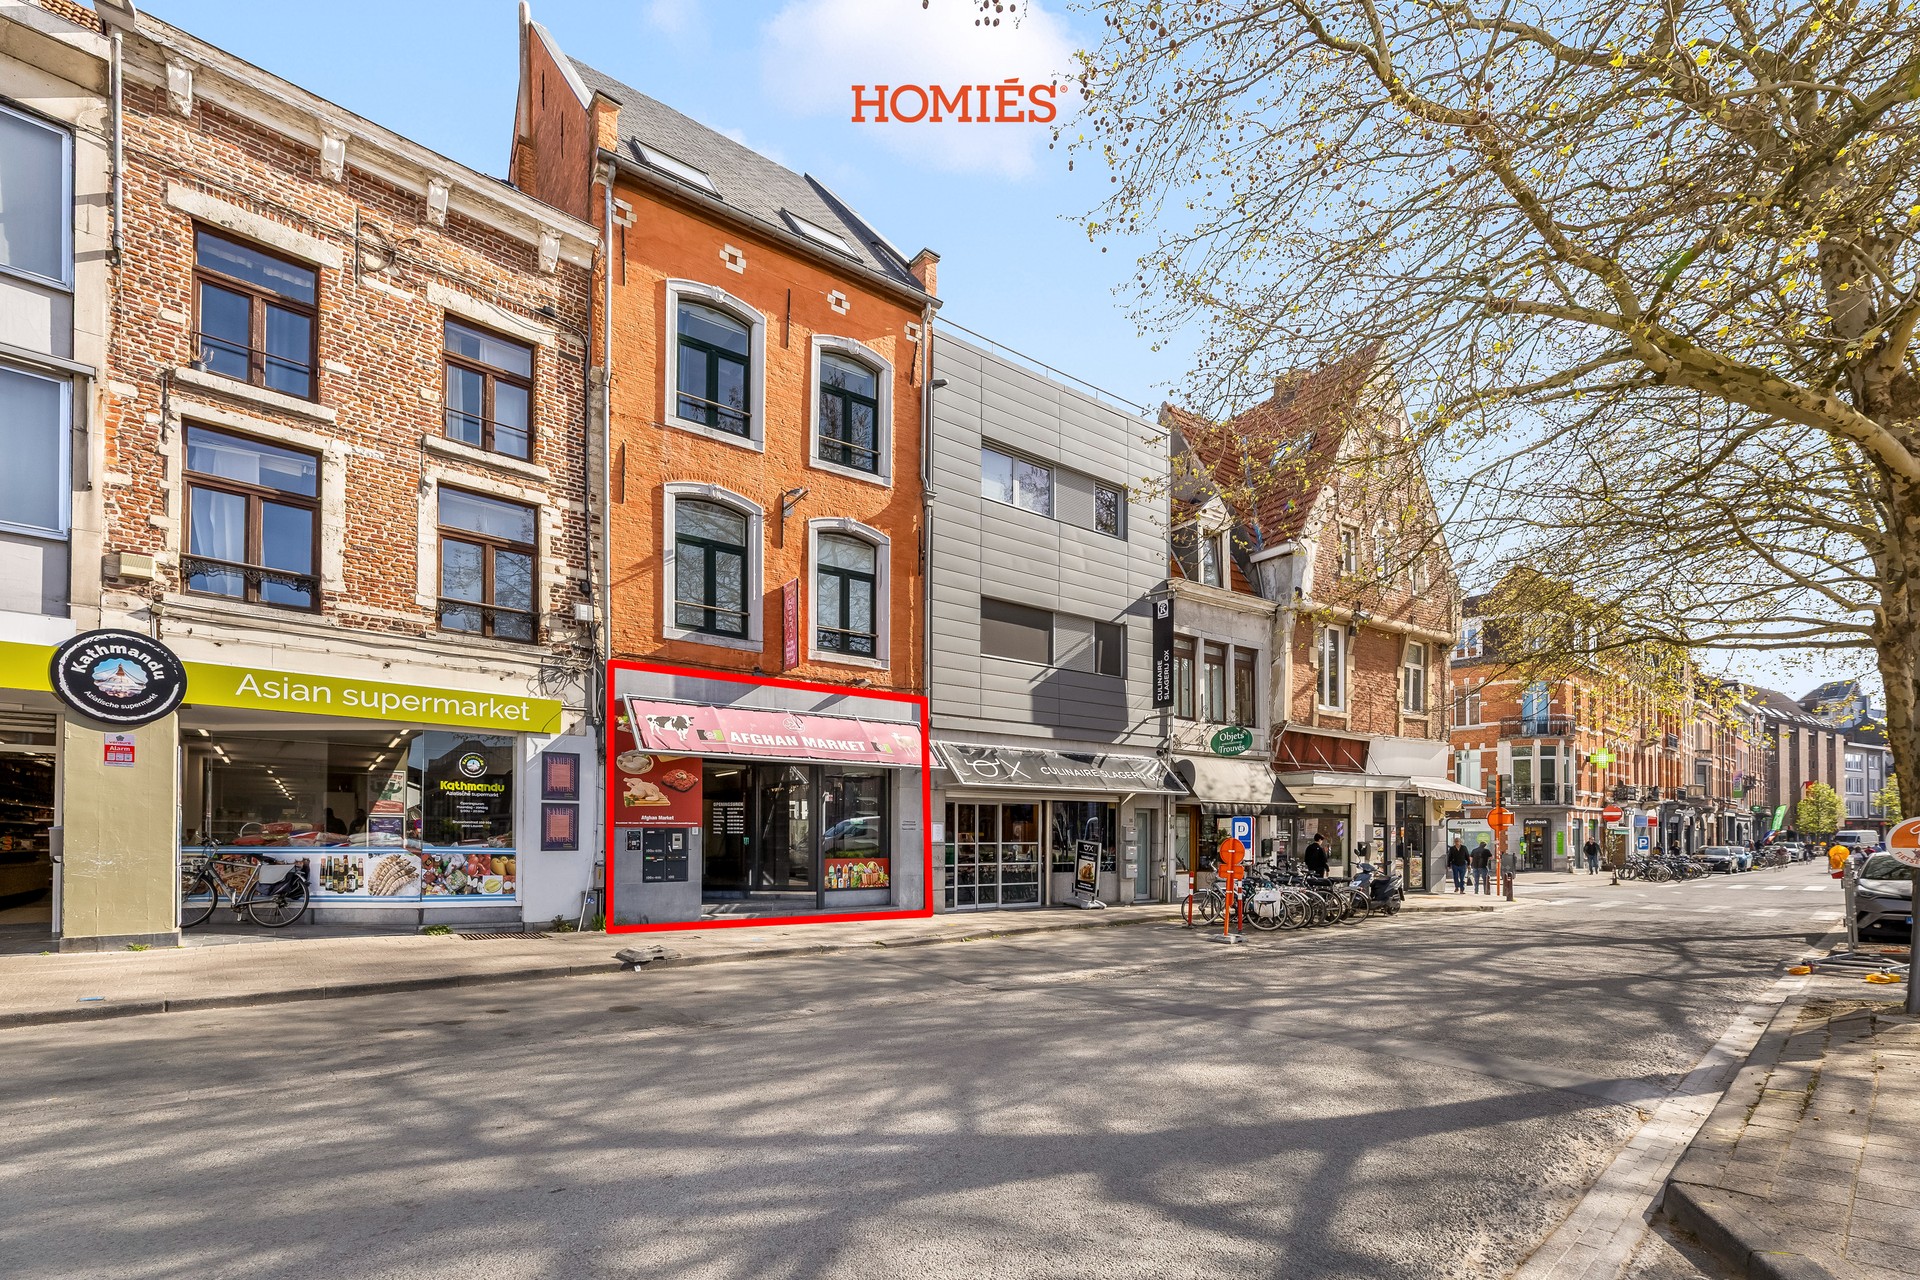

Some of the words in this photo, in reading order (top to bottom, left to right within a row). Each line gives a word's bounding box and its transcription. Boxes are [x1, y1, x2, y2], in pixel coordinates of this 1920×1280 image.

[70, 644, 165, 680] Kathmandu
[1163, 649, 1170, 662] OX
[84, 690, 120, 709] Aziatische
[120, 692, 159, 710] supermarkt
[235, 673, 331, 704] Asian
[342, 688, 530, 721] supermarket
[729, 731, 799, 746] AFGHAN
[803, 736, 865, 751] MARKET
[1219, 732, 1245, 743] Objets
[1040, 766, 1100, 778] CULINAIRE
[1101, 770, 1147, 780] SLAGERIJ
[440, 781, 505, 792] Kathmandu
[1639, 838, 1648, 848] P
